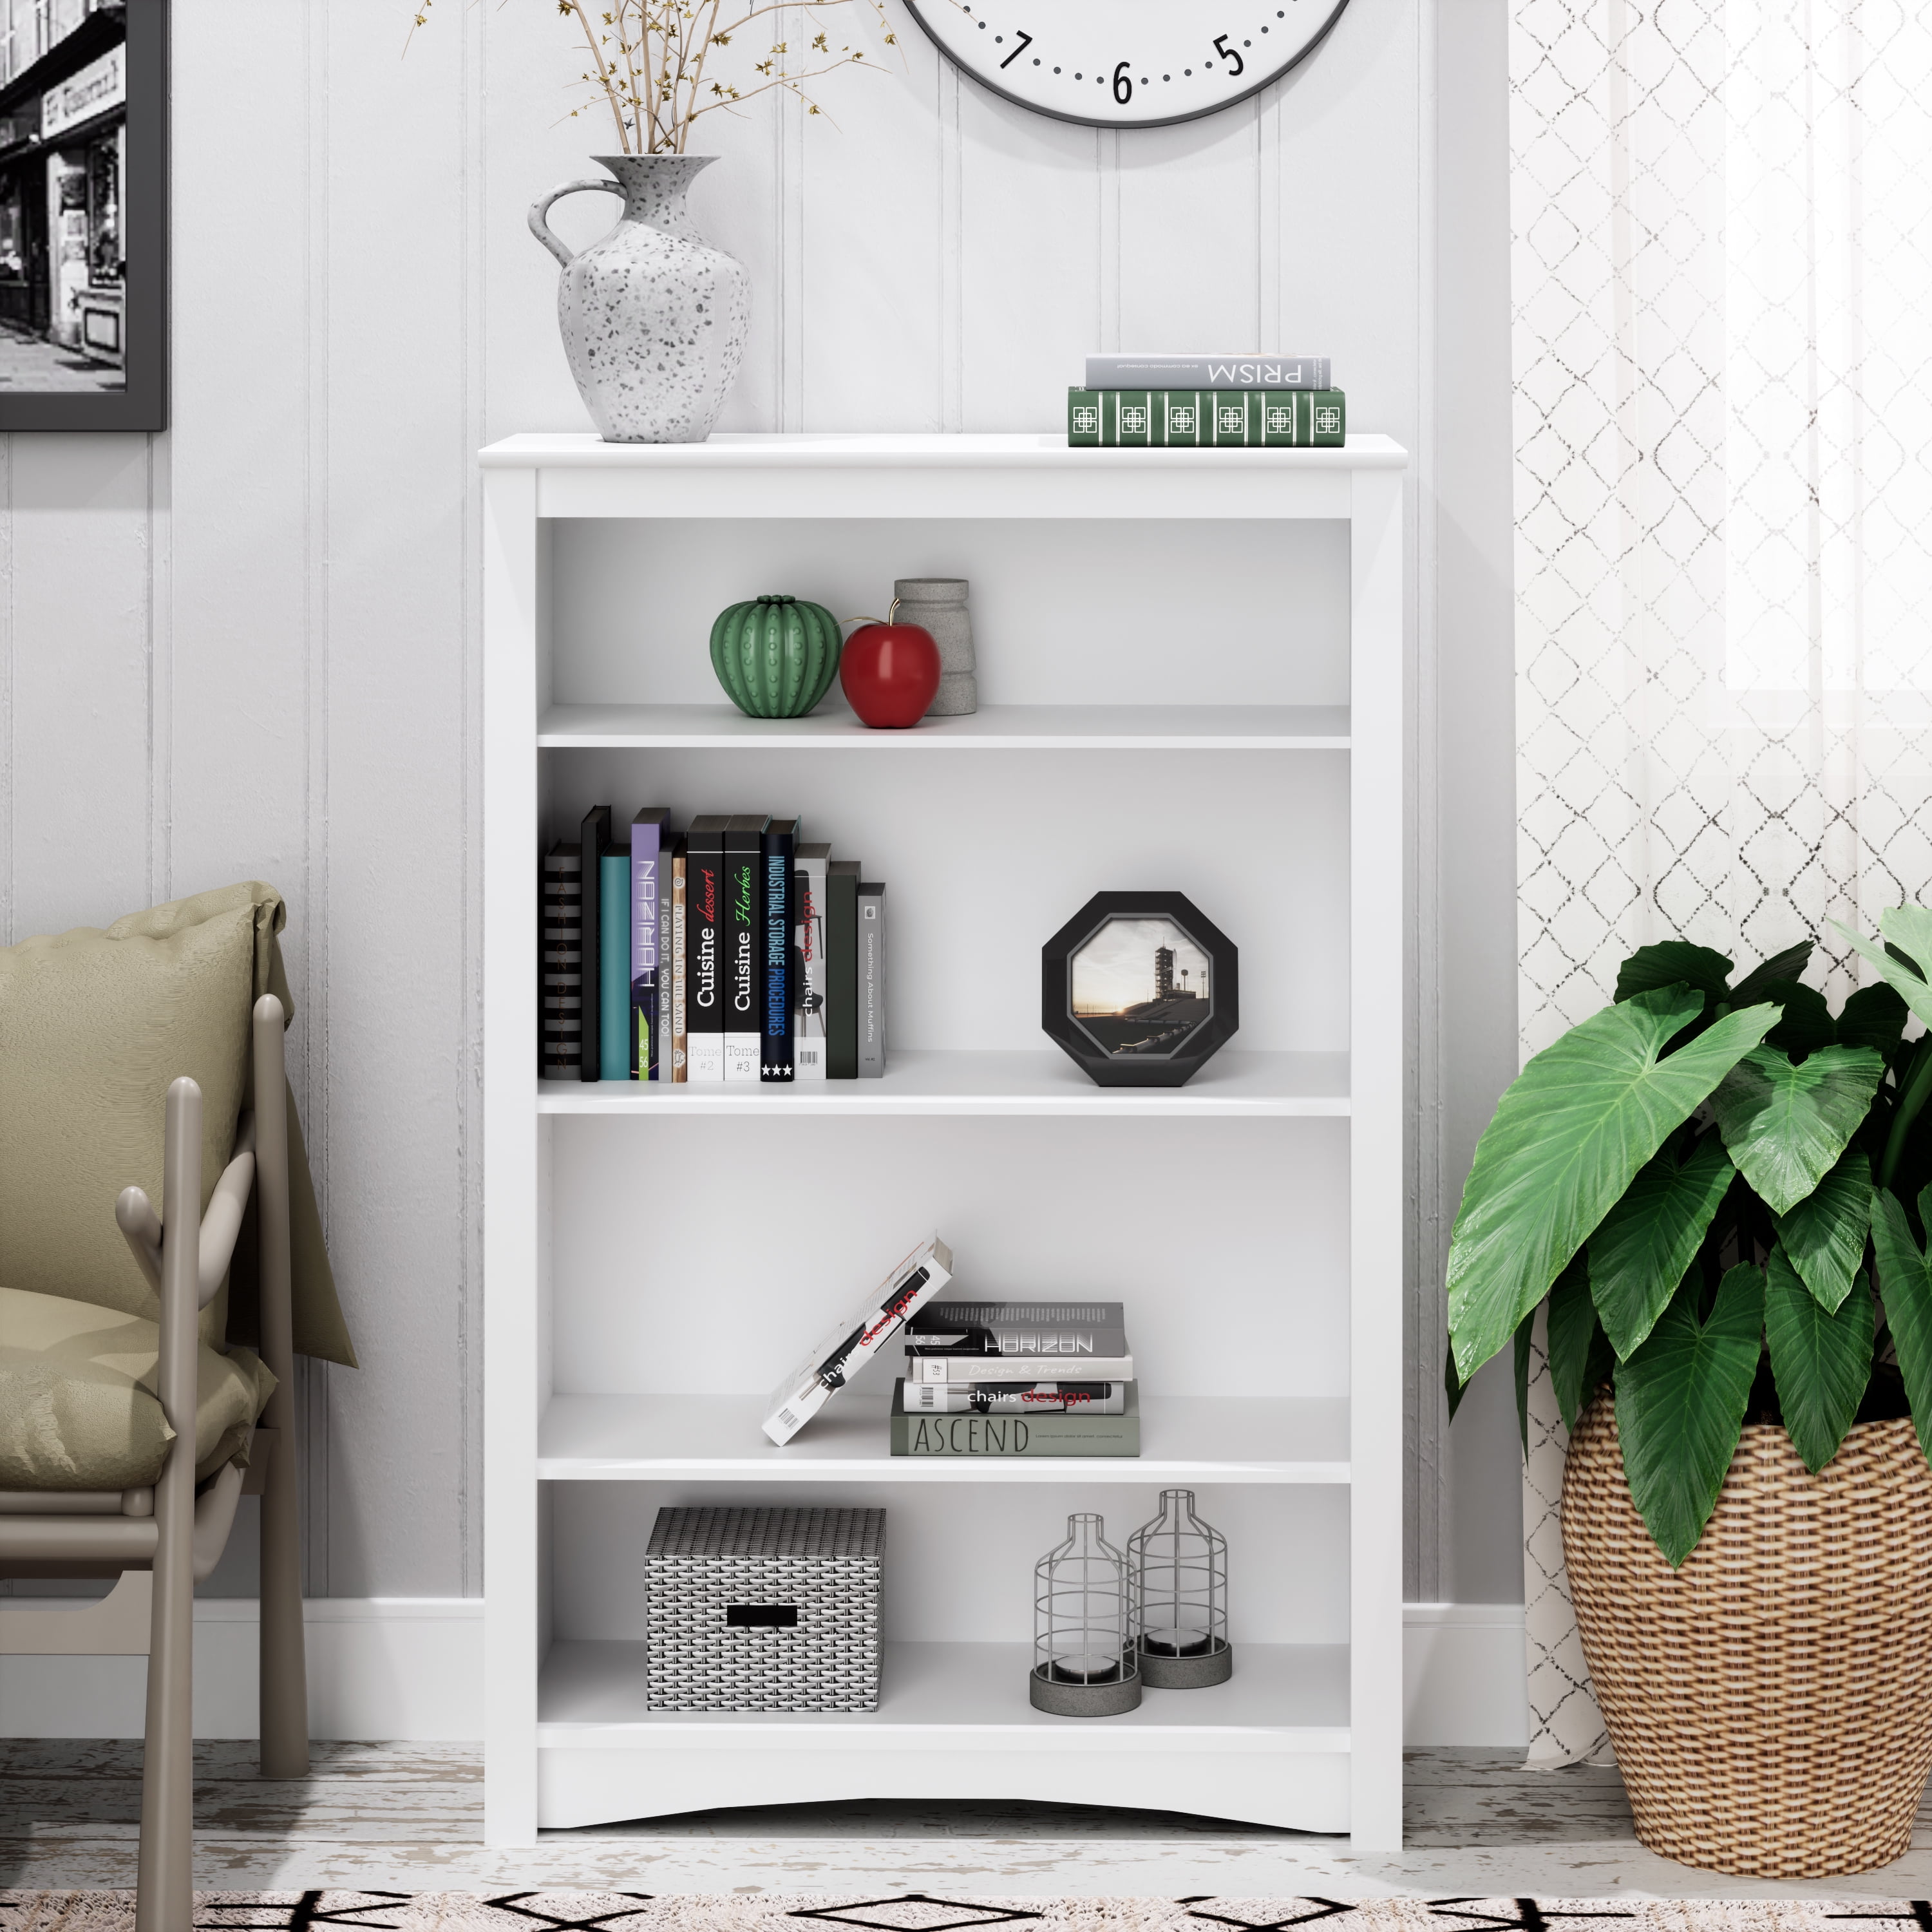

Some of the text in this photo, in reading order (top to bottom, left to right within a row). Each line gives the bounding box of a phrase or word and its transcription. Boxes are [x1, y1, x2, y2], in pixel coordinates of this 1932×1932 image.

[999, 30, 1033, 69] 7
[1213, 33, 1244, 76] 5
[1113, 61, 1132, 104] 6
[1208, 364, 1302, 384] PRISM
[661, 898, 670, 907] IF
[637, 860, 655, 987] HORIZON
[661, 914, 670, 934] CAN
[661, 936, 670, 951] DO
[696, 869, 714, 1007] Cuisine dessert
[734, 866, 751, 1011] Cuisine Herbes
[768, 856, 785, 1036] INDUSTRIAL STORAGE PROCEDURES
[660, 953, 670, 964] IT,
[800, 891, 816, 1017] chairs design
[556, 866, 568, 1071] FASHION DESIGN
[675, 905, 683, 1034] PLAYING IN THE SAND
[661, 969, 670, 989] YOU
[661, 991, 670, 1011] CAN
[661, 1014, 670, 1037] TOO!
[639, 1039, 649, 1050] 45
[688, 1046, 722, 1057] Tome
[726, 1045, 760, 1057] Tome
[639, 1056, 649, 1068] 56
[700, 1061, 714, 1071] #2
[736, 1061, 750, 1072] #3
[860, 1290, 918, 1347] design
[915, 1335, 926, 1345] 56
[930, 1335, 940, 1345] 45
[985, 1332, 1093, 1352] HORIZON
[968, 1365, 1083, 1376] Design & Trends
[967, 1388, 1090, 1406] chairs design
[914, 1418, 1028, 1452] ASCEND
